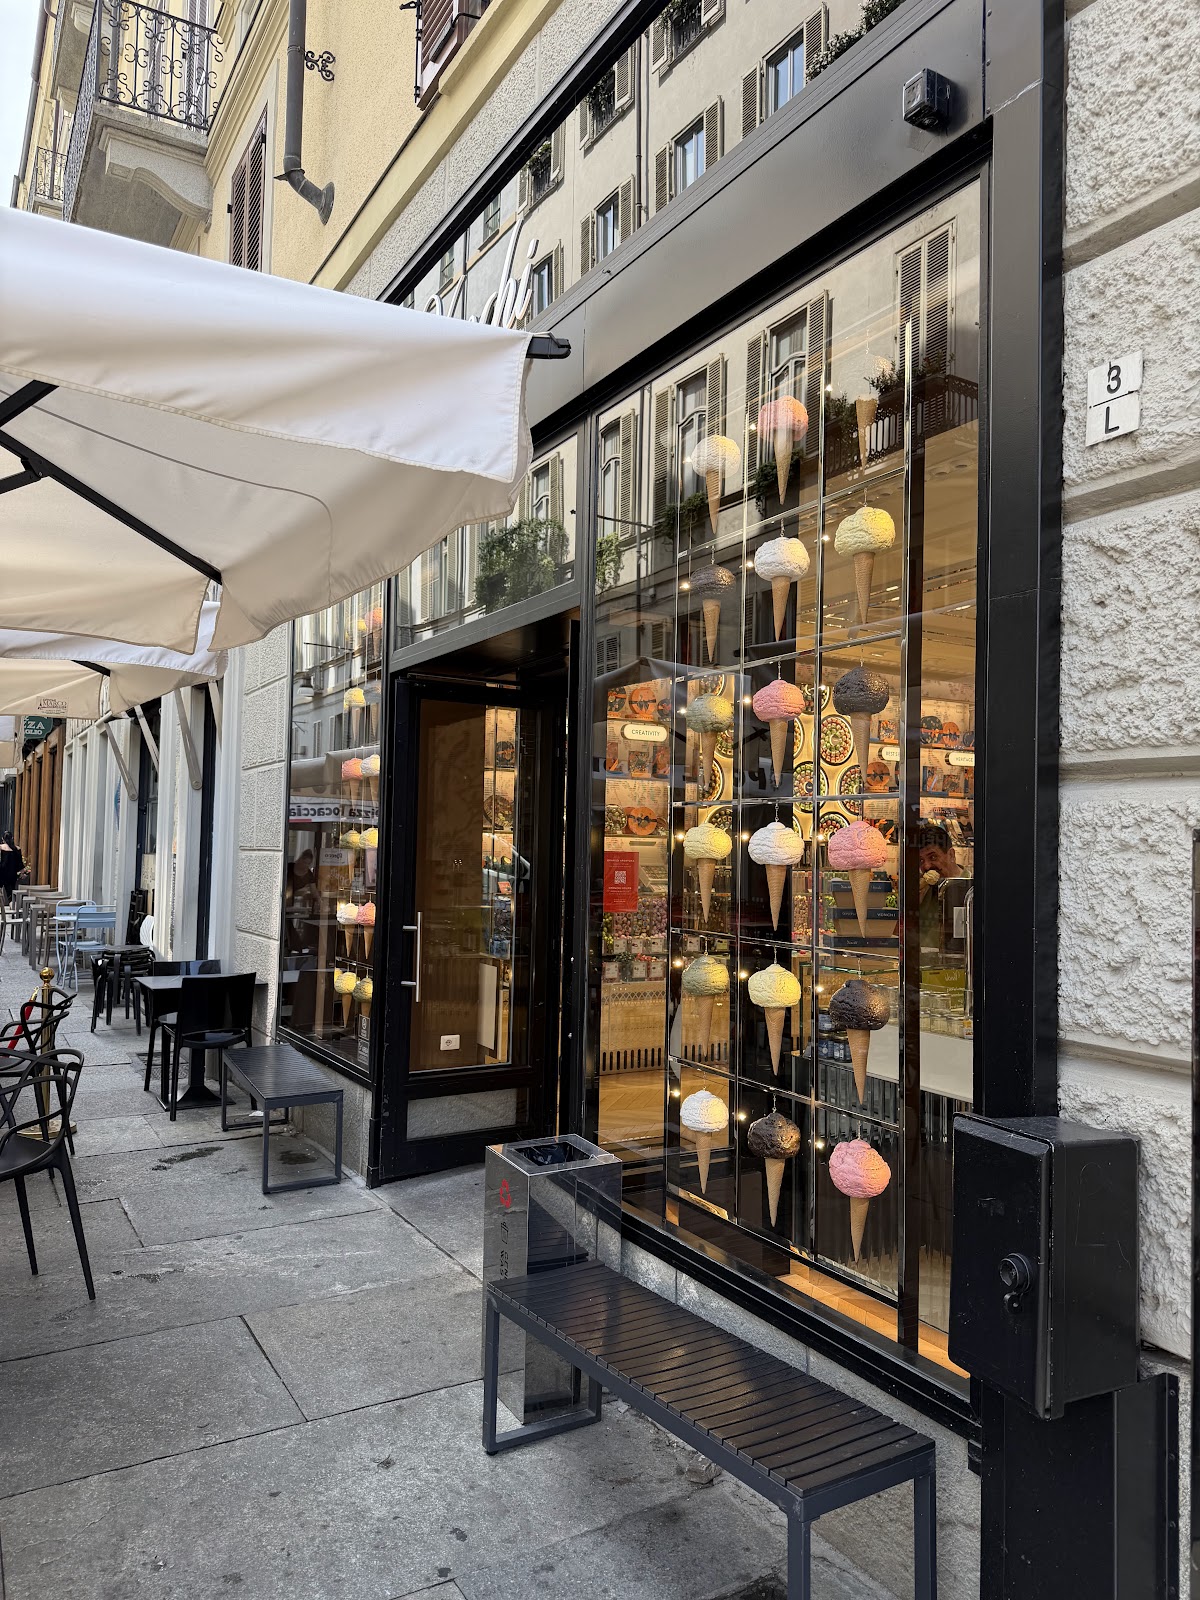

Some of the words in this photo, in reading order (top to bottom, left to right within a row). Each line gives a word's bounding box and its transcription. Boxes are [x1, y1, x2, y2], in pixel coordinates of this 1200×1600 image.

[1106, 365, 1121, 394] 3
[1105, 406, 1120, 434] L
[631, 728, 661, 737] CREATIVITY
